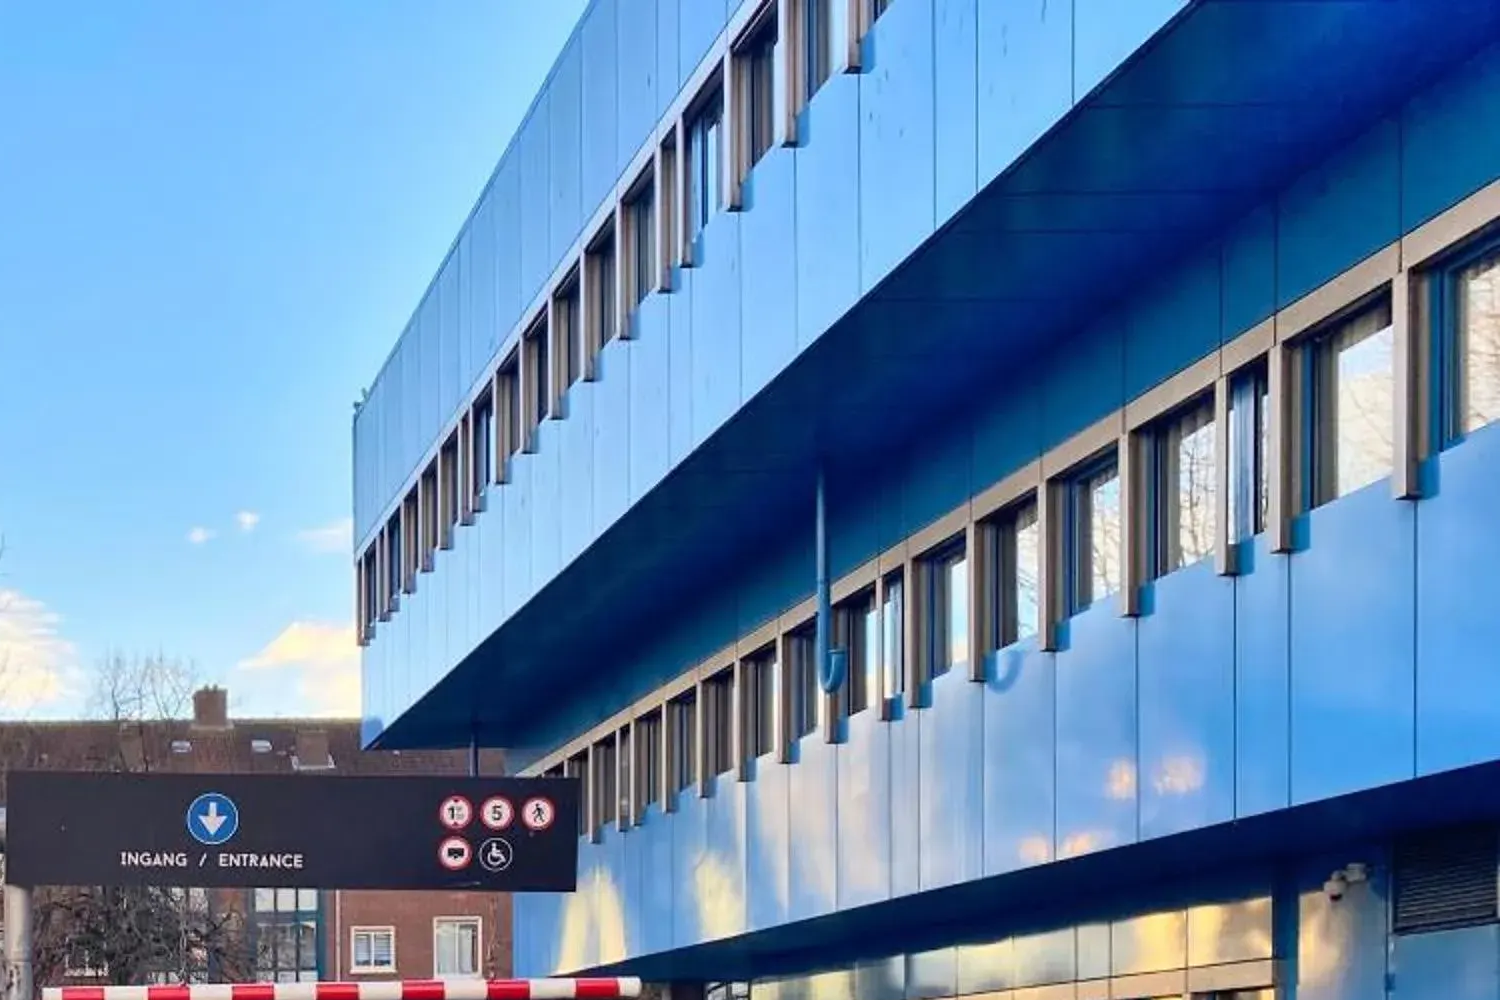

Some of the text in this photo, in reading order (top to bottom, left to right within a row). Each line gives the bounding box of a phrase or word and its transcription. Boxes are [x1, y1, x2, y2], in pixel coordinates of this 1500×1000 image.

[491, 805, 503, 821] 5
[120, 852, 303, 868] INGANG / ENTRANCE
